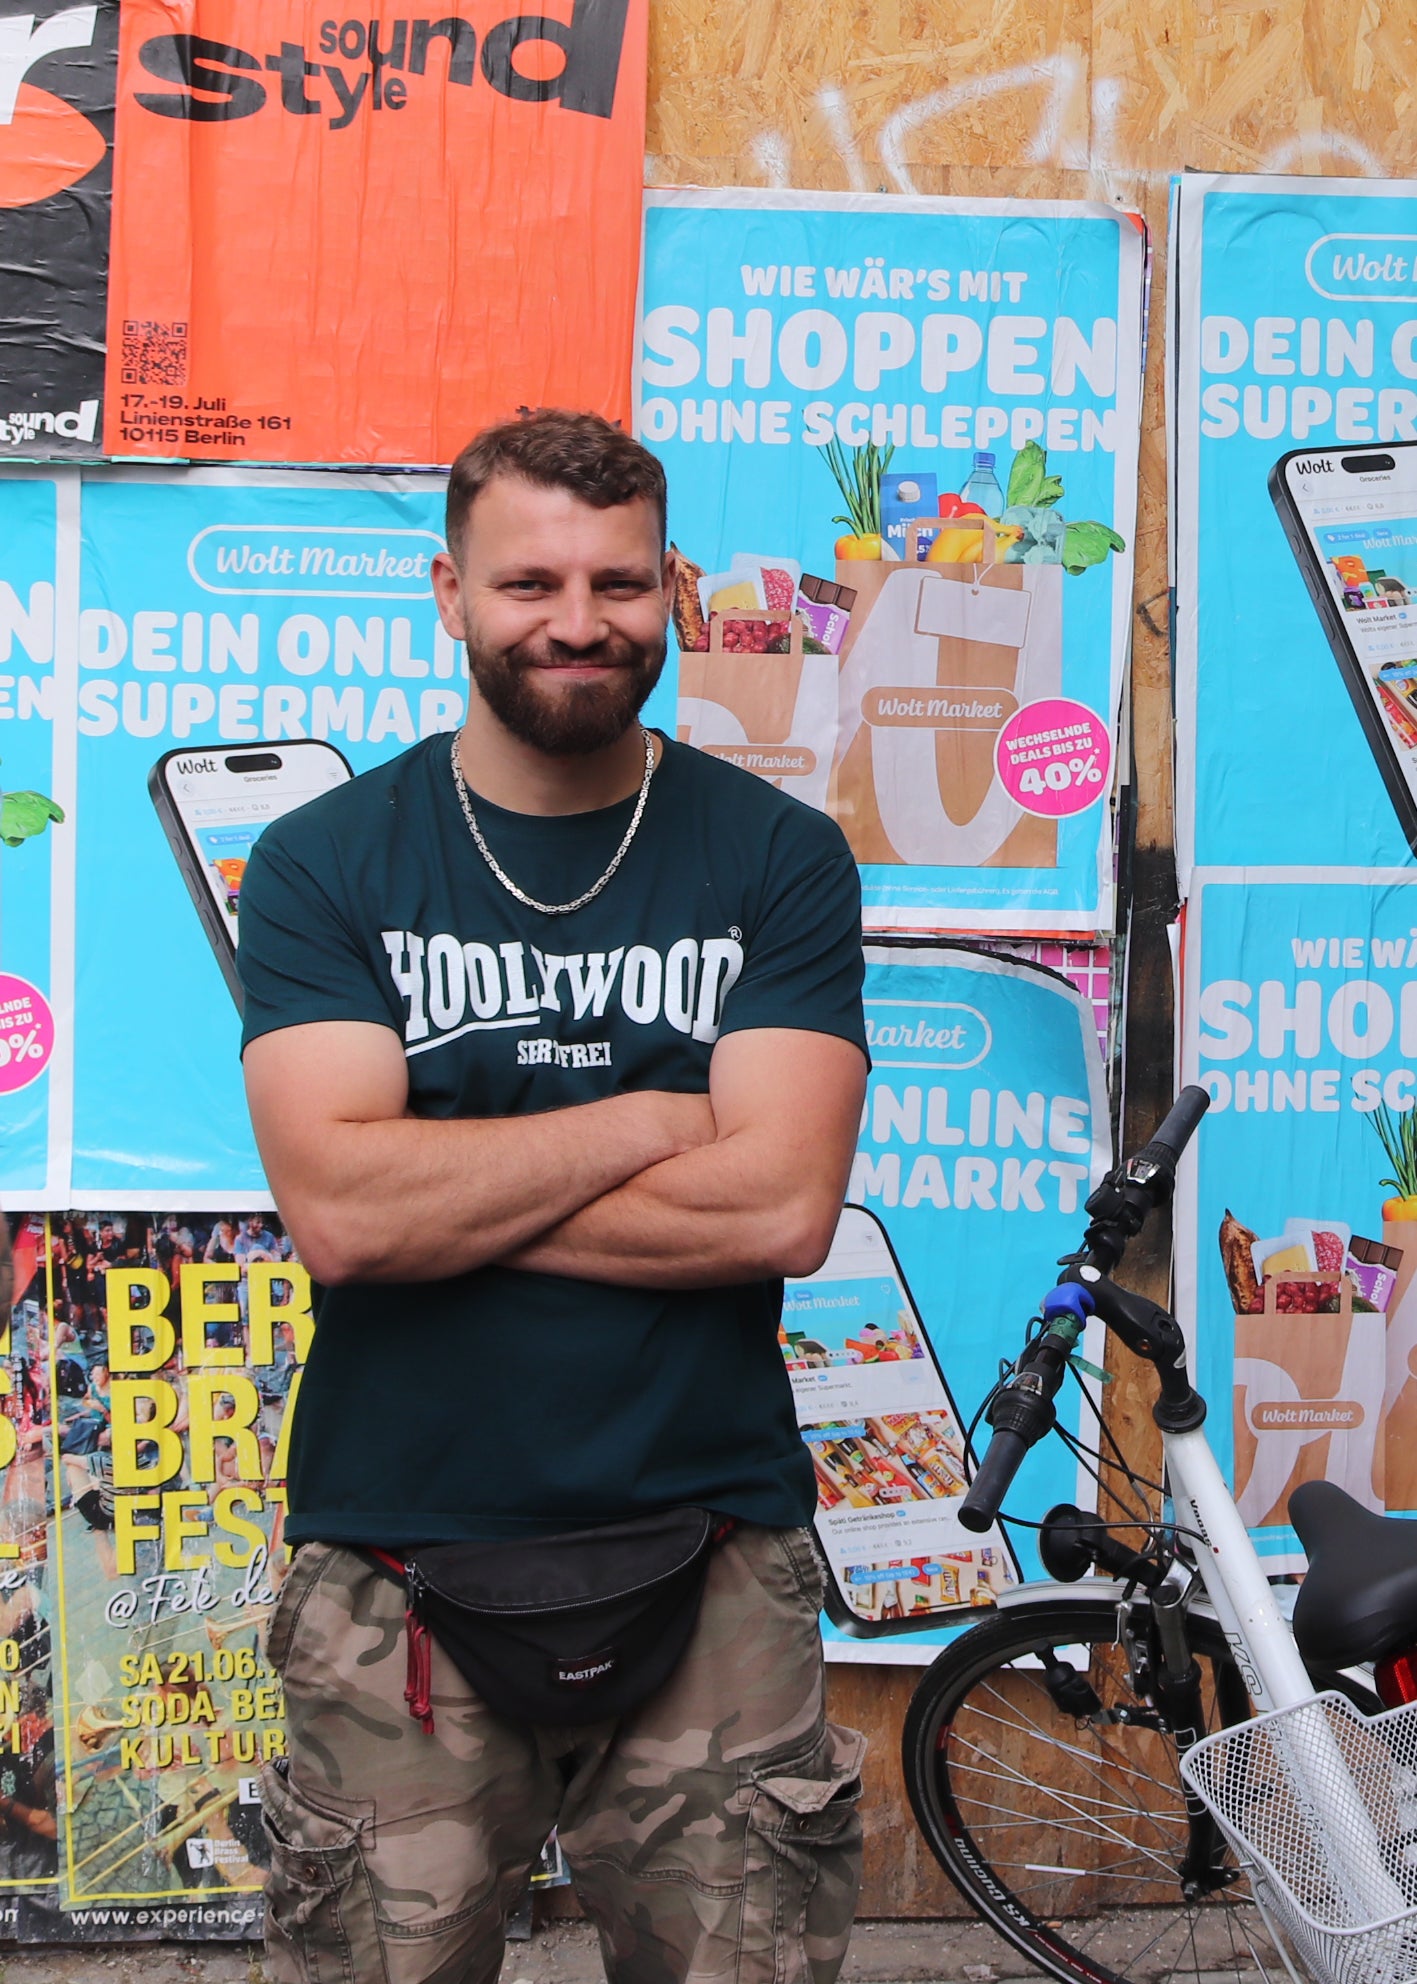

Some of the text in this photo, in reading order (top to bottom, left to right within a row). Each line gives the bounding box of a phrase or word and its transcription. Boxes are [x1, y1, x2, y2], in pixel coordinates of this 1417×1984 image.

[741, 256, 1028, 303] WIE WÄR'S MIT
[1332, 253, 1408, 282] Wolt
[642, 305, 1117, 398] SHOPPEN
[1201, 315, 1374, 378] DEIN
[121, 394, 227, 412] 17.-19. Juli
[9, 400, 99, 443] sound
[120, 411, 291, 430] Linienstraße 161
[640, 398, 1116, 452] OHNE SCHLEPPEN
[120, 428, 245, 446] 10115 Berlin
[1296, 459, 1335, 475] Wolt
[217, 545, 429, 579] Wolt Market
[79, 608, 469, 679] DEIN ONLI
[877, 698, 1004, 720] Wolt Market
[1005, 722, 1092, 751] WECHSELNDE
[177, 759, 218, 775] Wolt
[747, 754, 805, 768] Market
[1010, 738, 1093, 766] DEALS BIS ZU
[1291, 938, 1365, 969] WIE
[381, 931, 744, 1044] HOOLYWOOD
[15, 1013, 34, 1026] ZU
[559, 1042, 612, 1069] FREI
[1199, 1069, 1341, 1114] OHNE
[860, 1084, 1091, 1154] NLINE
[846, 1153, 1089, 1215] MARKT
[106, 1262, 315, 1373] BER
[1262, 1409, 1354, 1424] Wolt Market
[119, 1654, 163, 1688] SA
[559, 1660, 612, 1681] EASTPAK
[121, 1690, 216, 1729] SODA
[1002, 1903, 1031, 1928] KS
